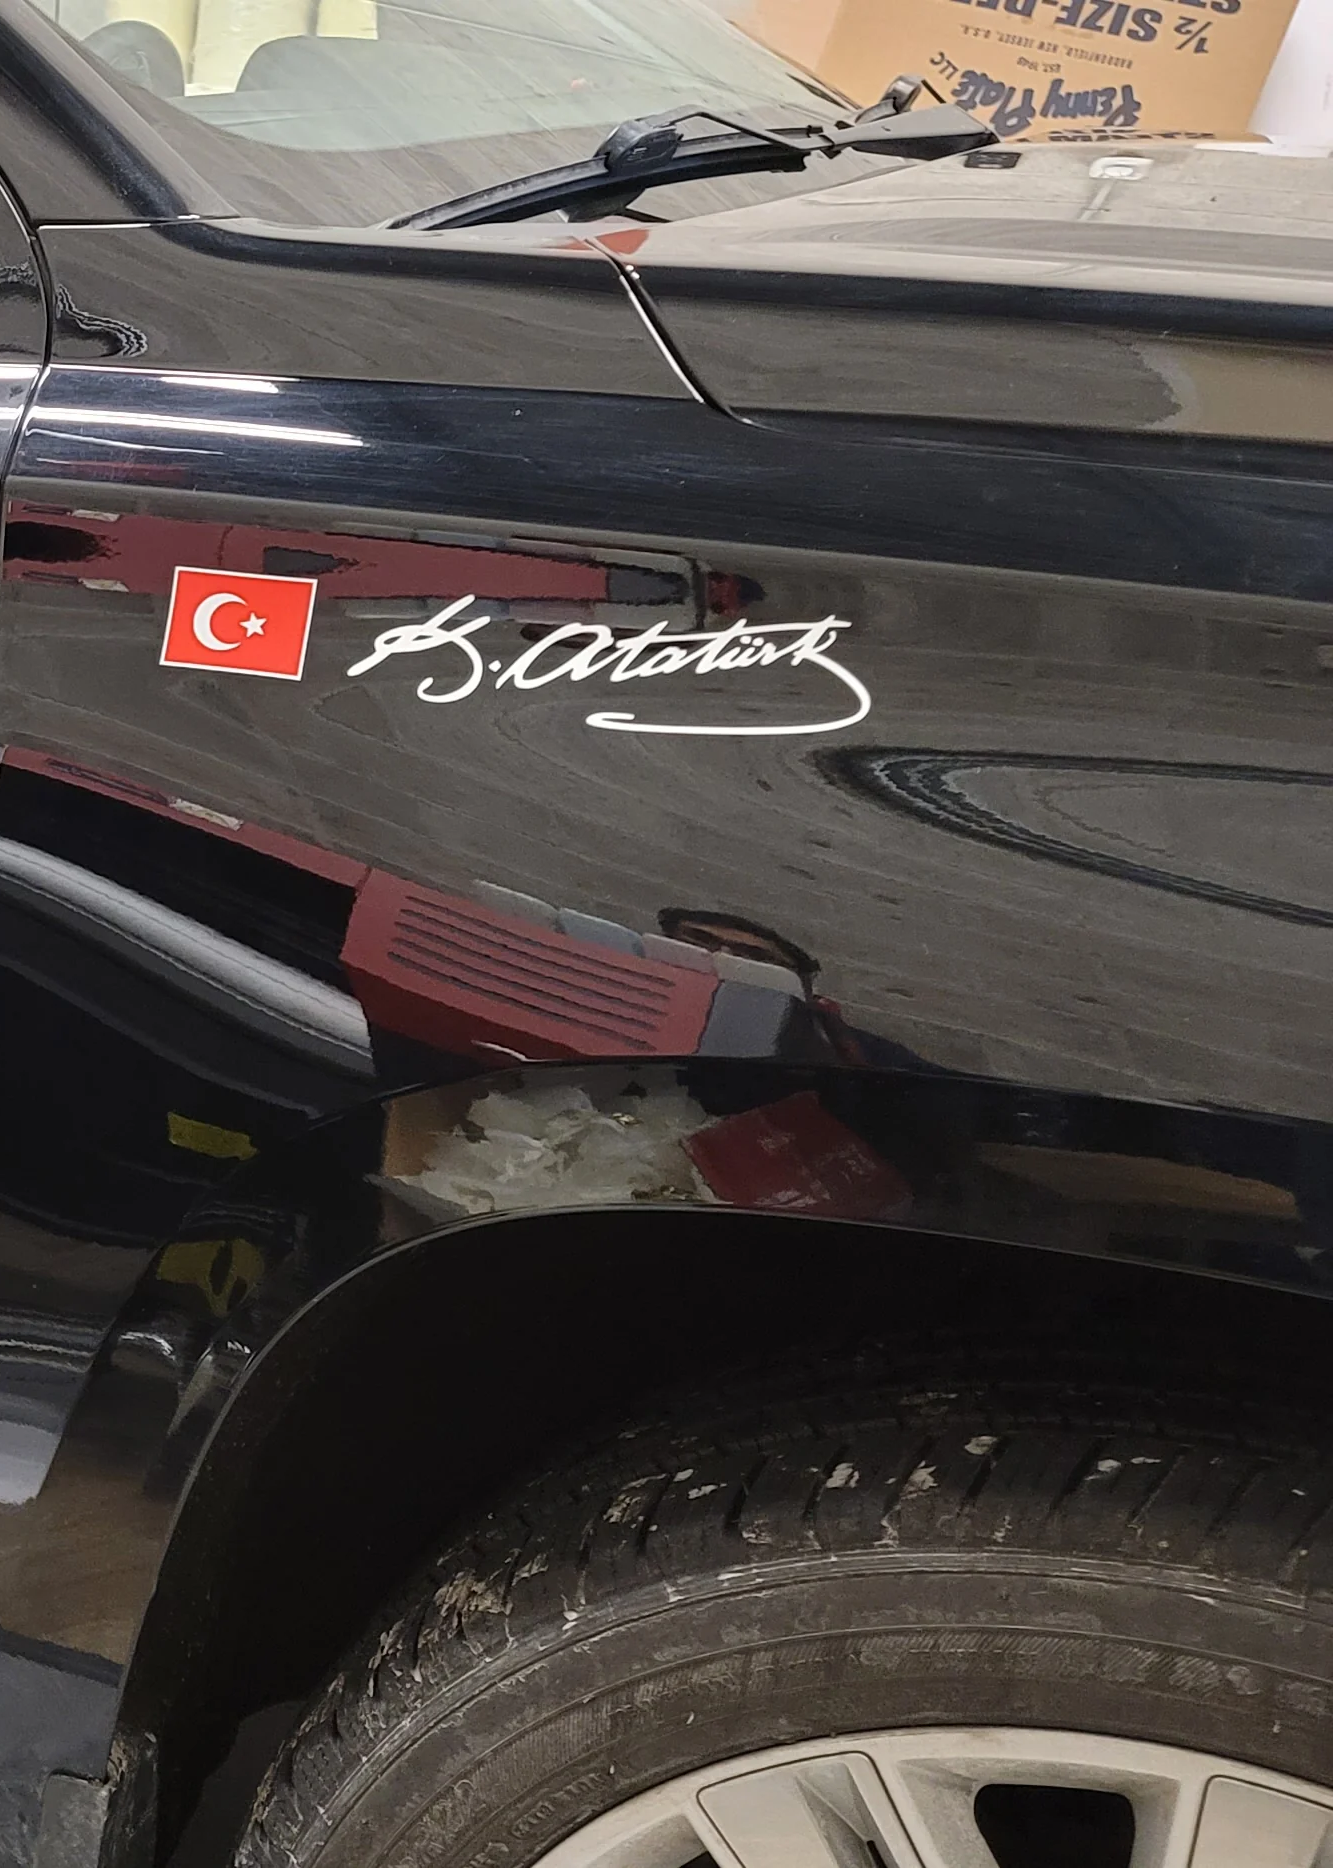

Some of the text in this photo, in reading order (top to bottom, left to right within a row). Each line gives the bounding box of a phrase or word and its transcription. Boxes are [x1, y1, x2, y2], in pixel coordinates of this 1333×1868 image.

[930, 51, 1142, 137] Penny Plate LLC
